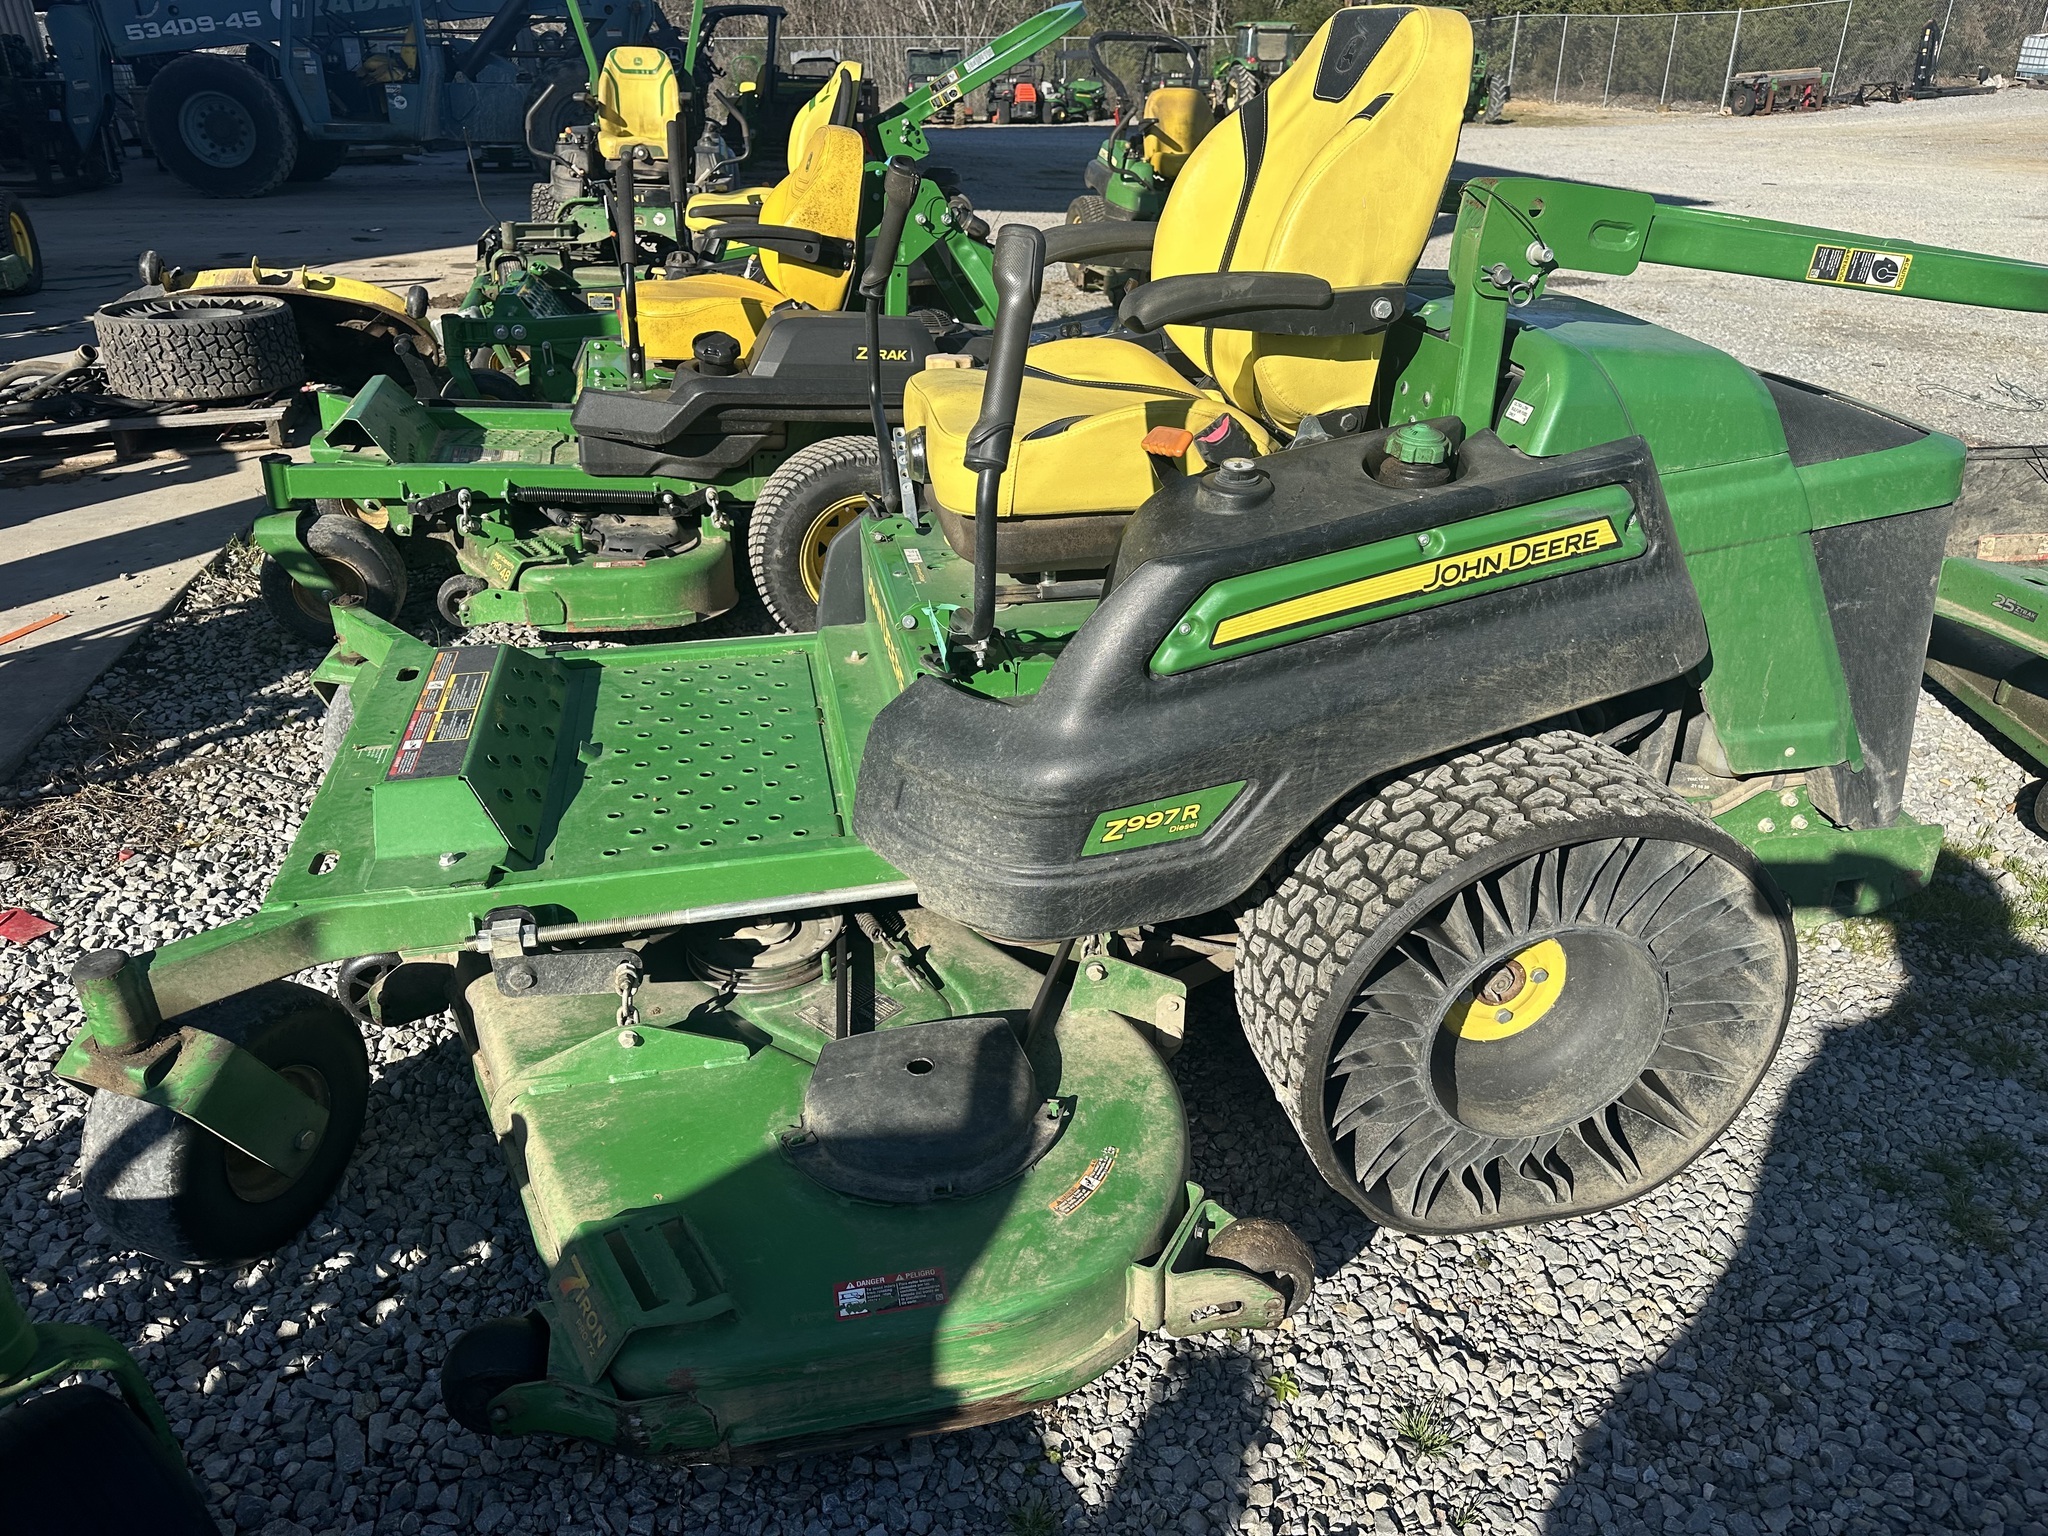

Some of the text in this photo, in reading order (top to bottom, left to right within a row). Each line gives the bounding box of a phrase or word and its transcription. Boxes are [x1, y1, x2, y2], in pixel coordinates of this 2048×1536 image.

[124, 10, 262, 41] 534D9-45
[1897, 262, 1909, 288] CAUTION
[855, 346, 908, 361] ZRAK
[1423, 529, 1599, 589] JOHN DEERE
[499, 567, 512, 582] 48
[1991, 592, 2017, 612] 25
[1101, 803, 1202, 843] Z997R
[1168, 821, 1198, 833] Diesel
[1392, 898, 1426, 928] TURF
[856, 1276, 886, 1288] DANGER
[905, 1268, 936, 1279] PELIGRO
